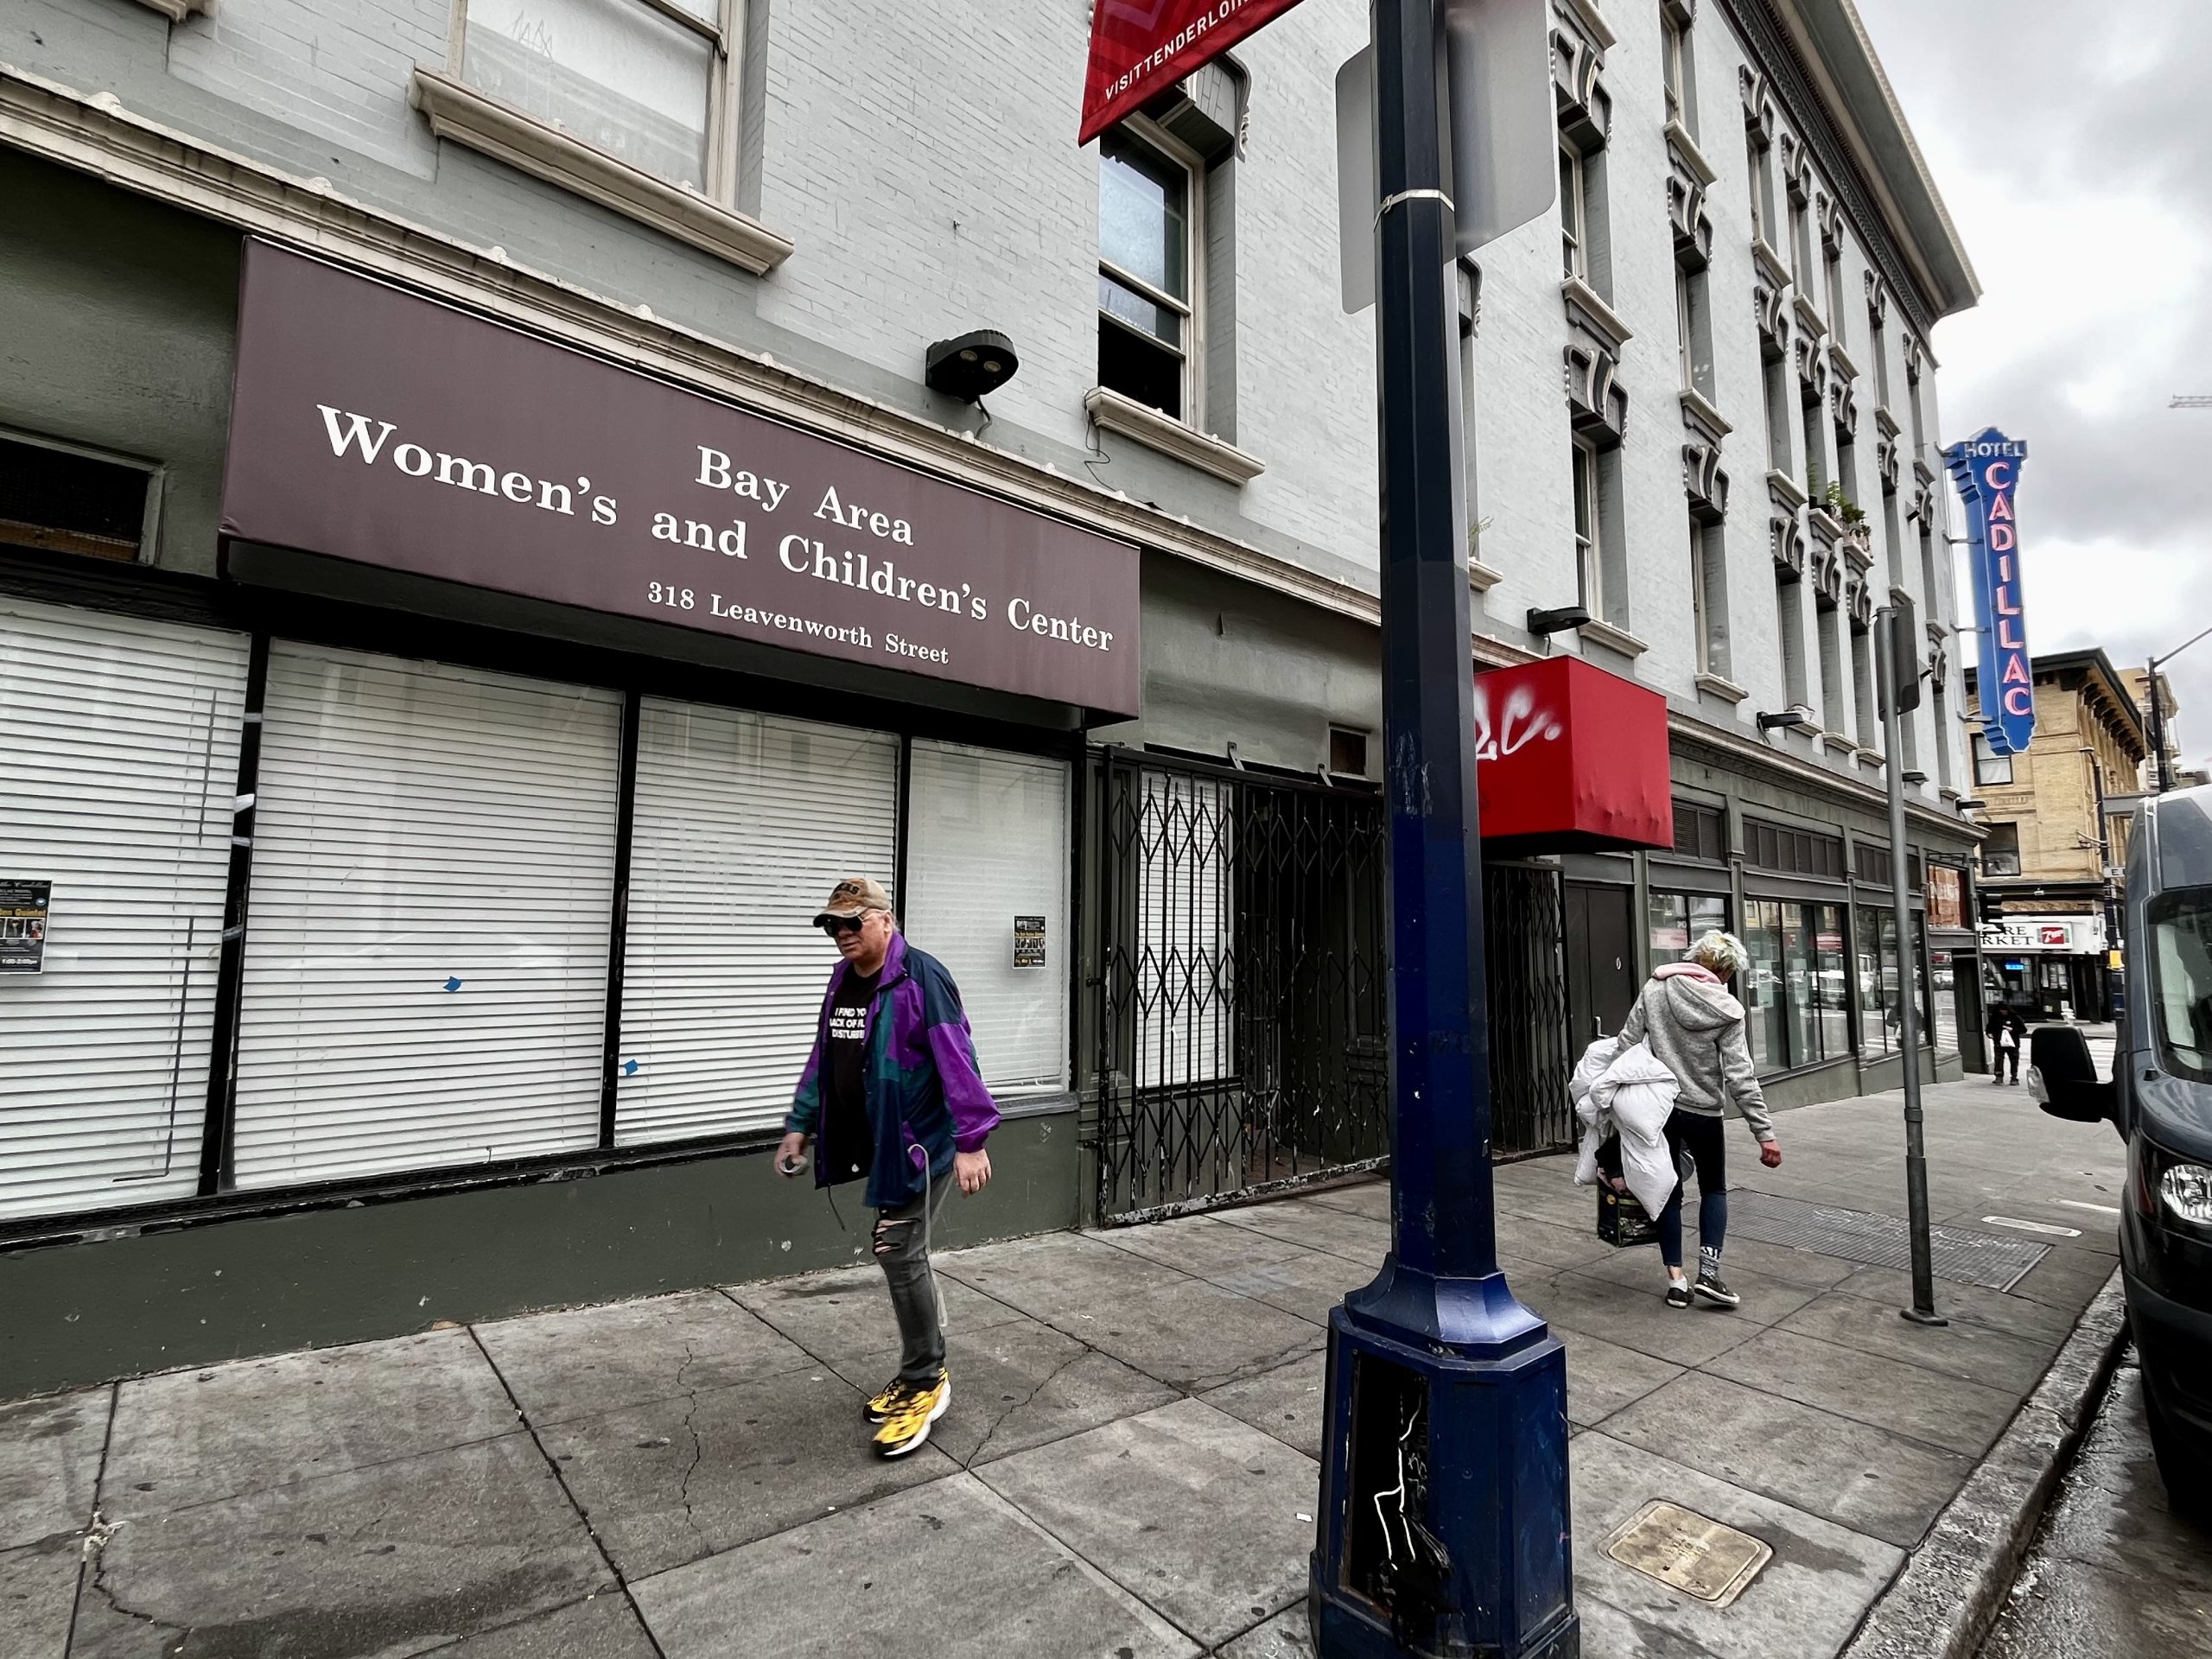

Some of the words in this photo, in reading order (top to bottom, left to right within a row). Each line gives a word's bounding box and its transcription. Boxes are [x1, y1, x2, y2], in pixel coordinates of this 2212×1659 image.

[1964, 442, 2024, 458] HOTEL
[316, 404, 617, 525] Women's
[651, 512, 748, 559] and
[779, 534, 988, 620] Children's
[1007, 597, 1114, 652] Center
[695, 445, 790, 512] Bay
[813, 486, 913, 546] Area
[648, 582, 695, 609] 318
[709, 594, 873, 648] Leavenworth
[885, 632, 949, 664] Street
[1985, 461, 2031, 716] CADILLAC
[835, 1007, 839, 1016] I
[838, 1007, 855, 1017] FIND
[846, 1019, 857, 1028] OF
